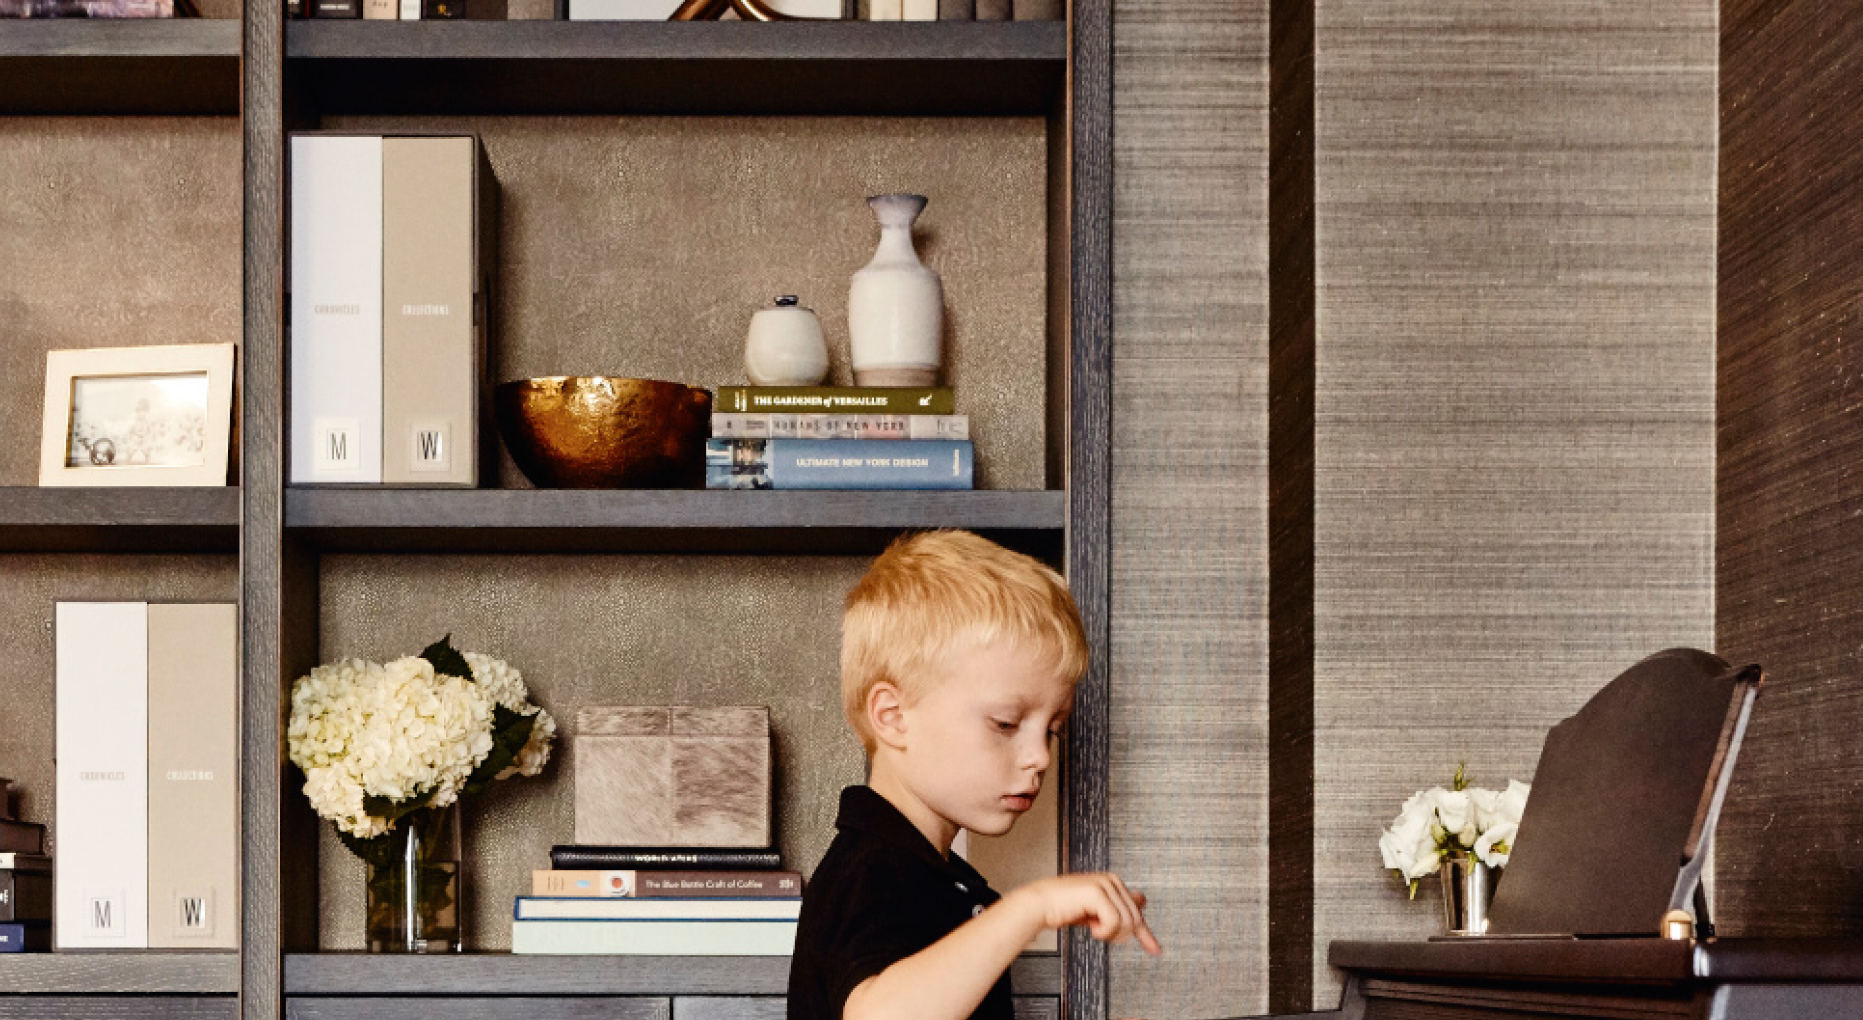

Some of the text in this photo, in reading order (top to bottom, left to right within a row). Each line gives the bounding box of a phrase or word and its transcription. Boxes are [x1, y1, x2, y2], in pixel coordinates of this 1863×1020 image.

[753, 395, 772, 406] THE
[773, 396, 822, 406] GARDENER
[832, 396, 888, 406] VERSAILLES
[772, 420, 820, 430] HUMANS
[826, 421, 839, 430] OF
[846, 422, 869, 430] NEW
[875, 422, 904, 431] YORK
[330, 431, 347, 460] M
[420, 431, 439, 460] W
[796, 458, 929, 467] ULTIMATE NEW YORK DESIGN
[645, 879, 763, 888] The Blue Bottle Craft of Coffee
[95, 900, 112, 929] M
[183, 898, 202, 927] W
